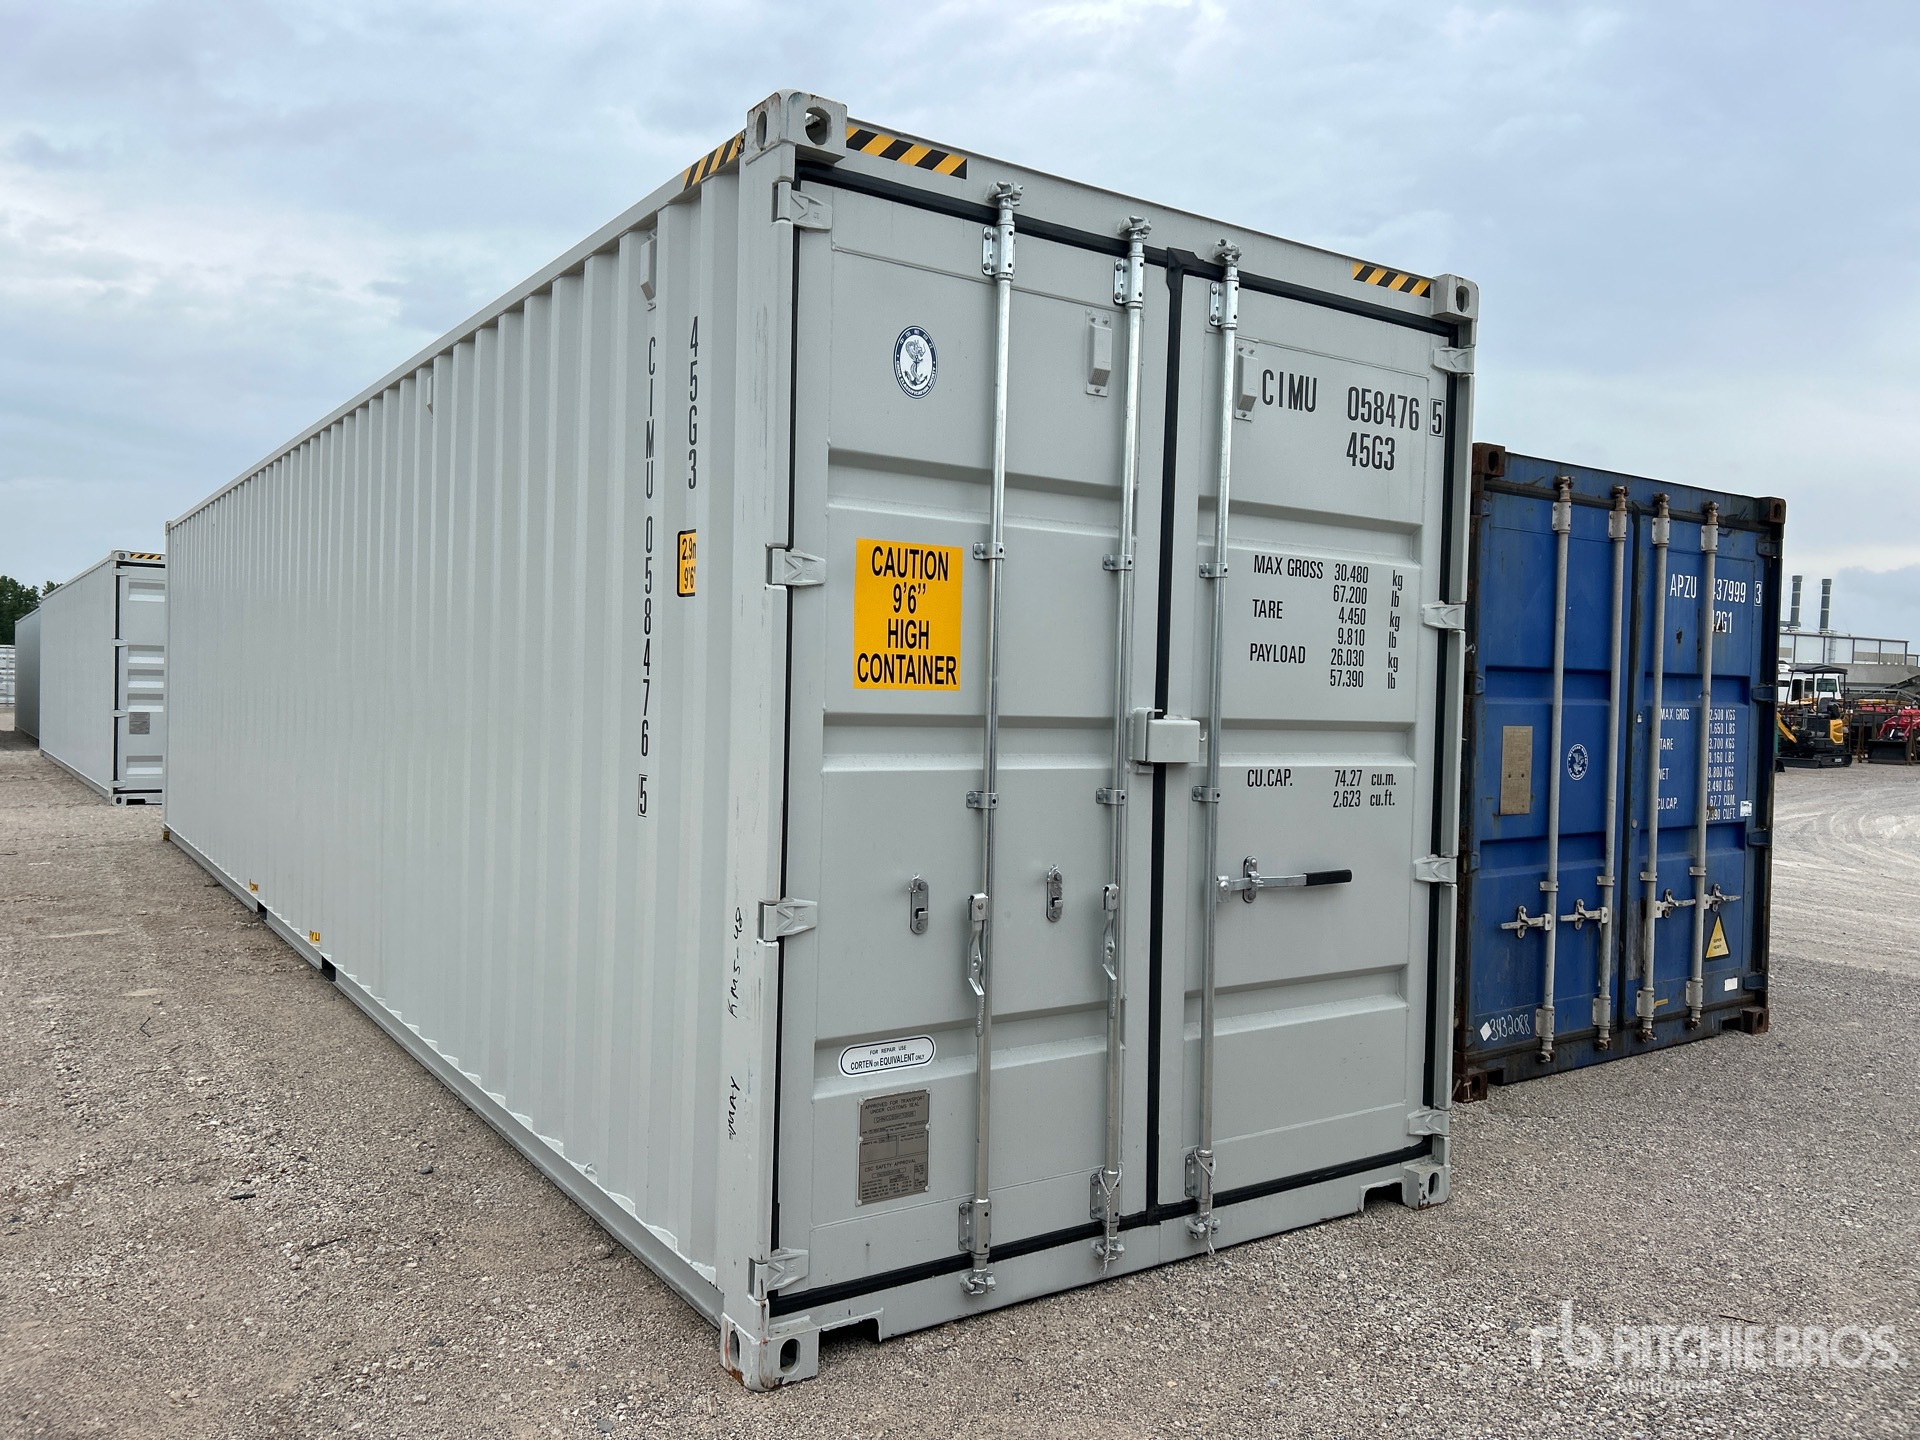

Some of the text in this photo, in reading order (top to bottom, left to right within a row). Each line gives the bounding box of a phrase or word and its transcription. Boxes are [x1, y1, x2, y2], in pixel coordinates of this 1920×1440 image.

[688, 316, 698, 490] 45G3
[1262, 369, 1443, 435] CIMU 058476 5
[1346, 431, 1395, 471] 45G3
[871, 546, 949, 581] CAUTION
[1253, 554, 1283, 576] MAX
[1287, 558, 1324, 580] GROSS
[1392, 569, 1403, 591] kg
[639, 336, 656, 815] CIMU 058476 5
[1669, 573, 1697, 599] APZU
[1755, 582, 1762, 605] 3
[1390, 591, 1400, 608] lb
[1252, 599, 1283, 619] TARE
[1389, 611, 1400, 632] kg
[887, 618, 930, 650] HIGH
[1388, 631, 1397, 649] lb
[1250, 643, 1306, 664] PAYLOAD
[1387, 651, 1399, 673] kg
[857, 652, 957, 685] CONTAINER
[1387, 672, 1396, 690] lb
[1725, 709, 1736, 721] KGS
[1725, 722, 1736, 735] LBS
[1660, 738, 1674, 750] TARE
[1725, 737, 1735, 749] KGS
[1725, 751, 1735, 763] LBS
[1247, 768, 1397, 788] CU.CAP. 74.27 cu.m.
[1724, 766, 1734, 778] KGS
[1723, 779, 1734, 792] LBS
[1369, 789, 1396, 807] cu.ft.
[1490, 1014, 1530, 1041] 3432088
[880, 1046, 896, 1054] REPAIR
[850, 1059, 874, 1071] CORTEN
[879, 1053, 915, 1067] EQUIVALENT
